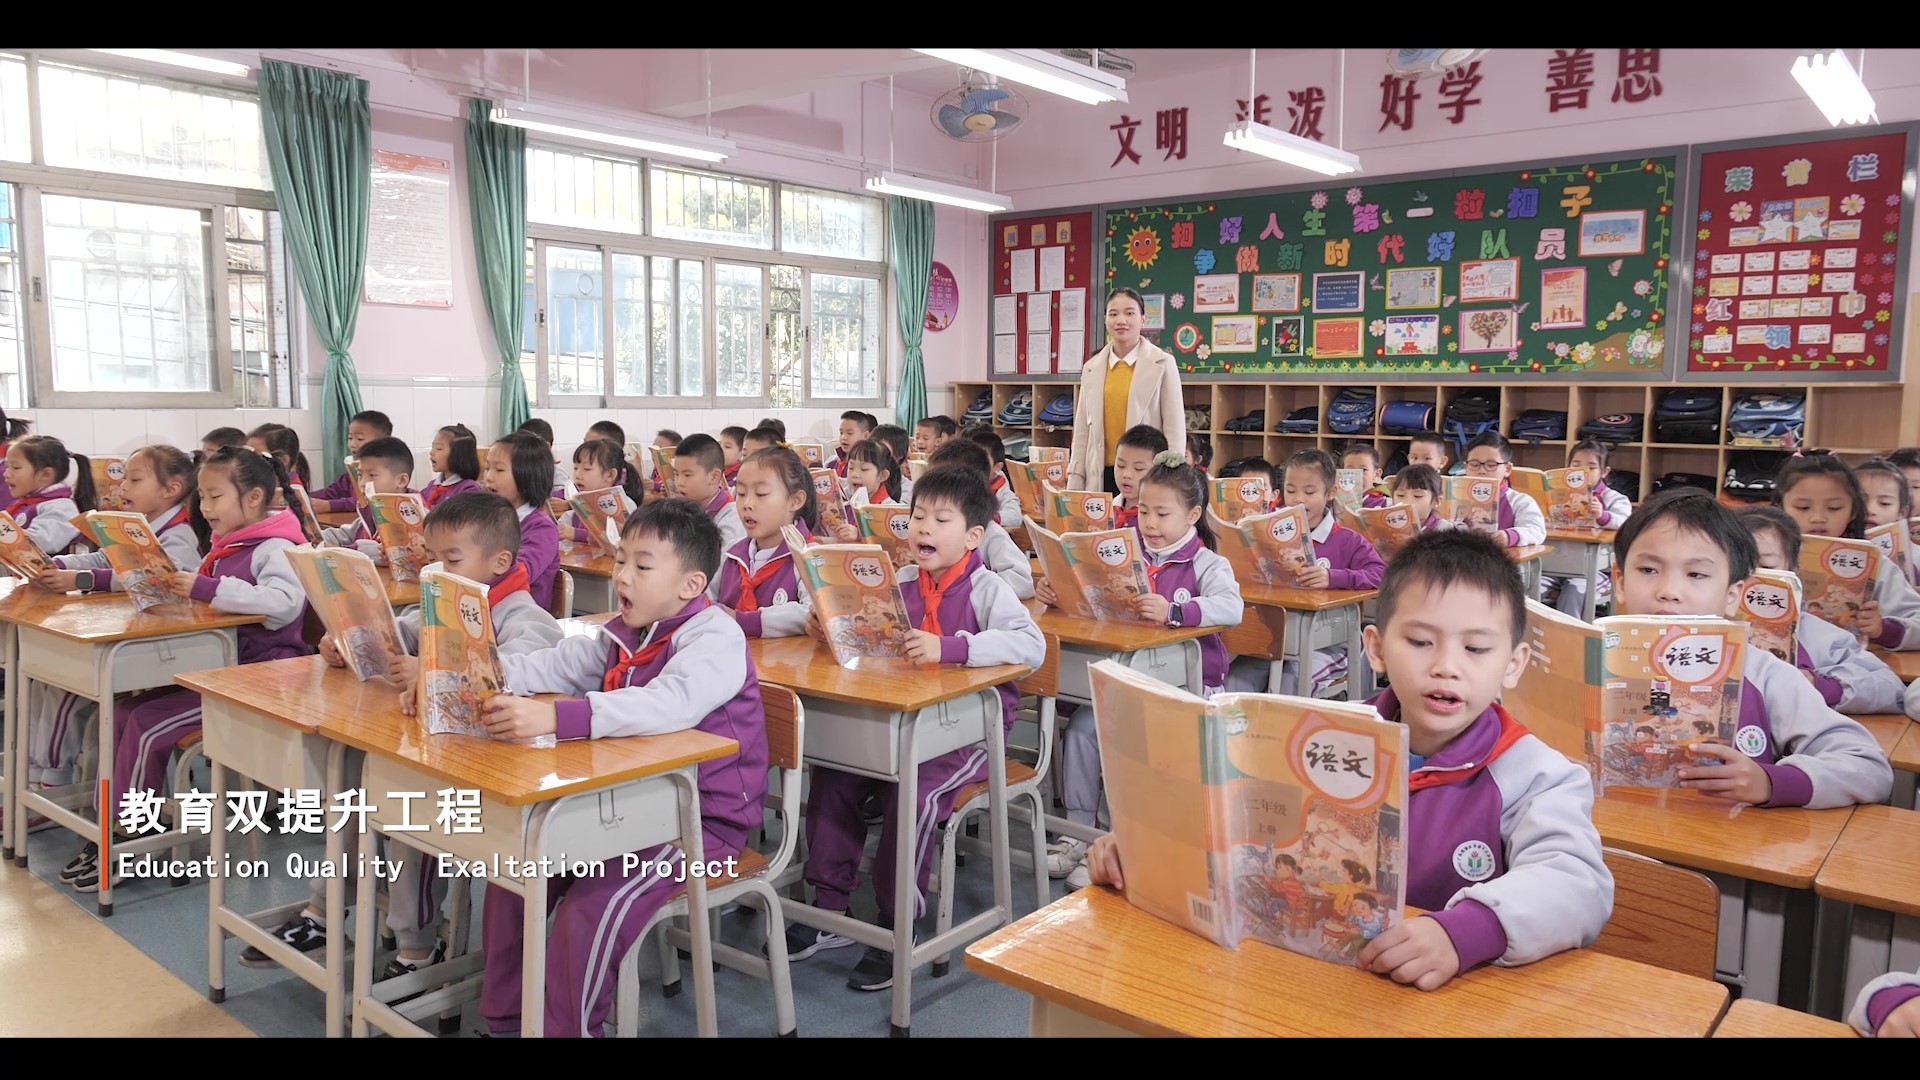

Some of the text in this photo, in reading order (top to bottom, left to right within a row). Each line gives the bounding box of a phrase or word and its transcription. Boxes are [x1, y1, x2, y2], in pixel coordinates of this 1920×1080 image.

[1109, 105, 1190, 168] 文明
[1378, 62, 1482, 132] 好学
[1546, 48, 1665, 112] 善思
[1170, 184, 1593, 250] 扣好人生第一粒扣子
[1192, 227, 1568, 275] 争做新时代好队员
[1085, 502, 1105, 513] 语文
[1273, 522, 1296, 536] 语文
[1098, 544, 1126, 558] 语文
[852, 563, 884, 577] 语文
[1831, 553, 1865, 570] 语文
[1746, 590, 1788, 610] 语文
[461, 602, 483, 626] 语文
[1665, 646, 1719, 667] 语文
[1305, 741, 1373, 780] 语文
[1245, 799, 1289, 818] 二年级
[1258, 823, 1278, 837] 上册
